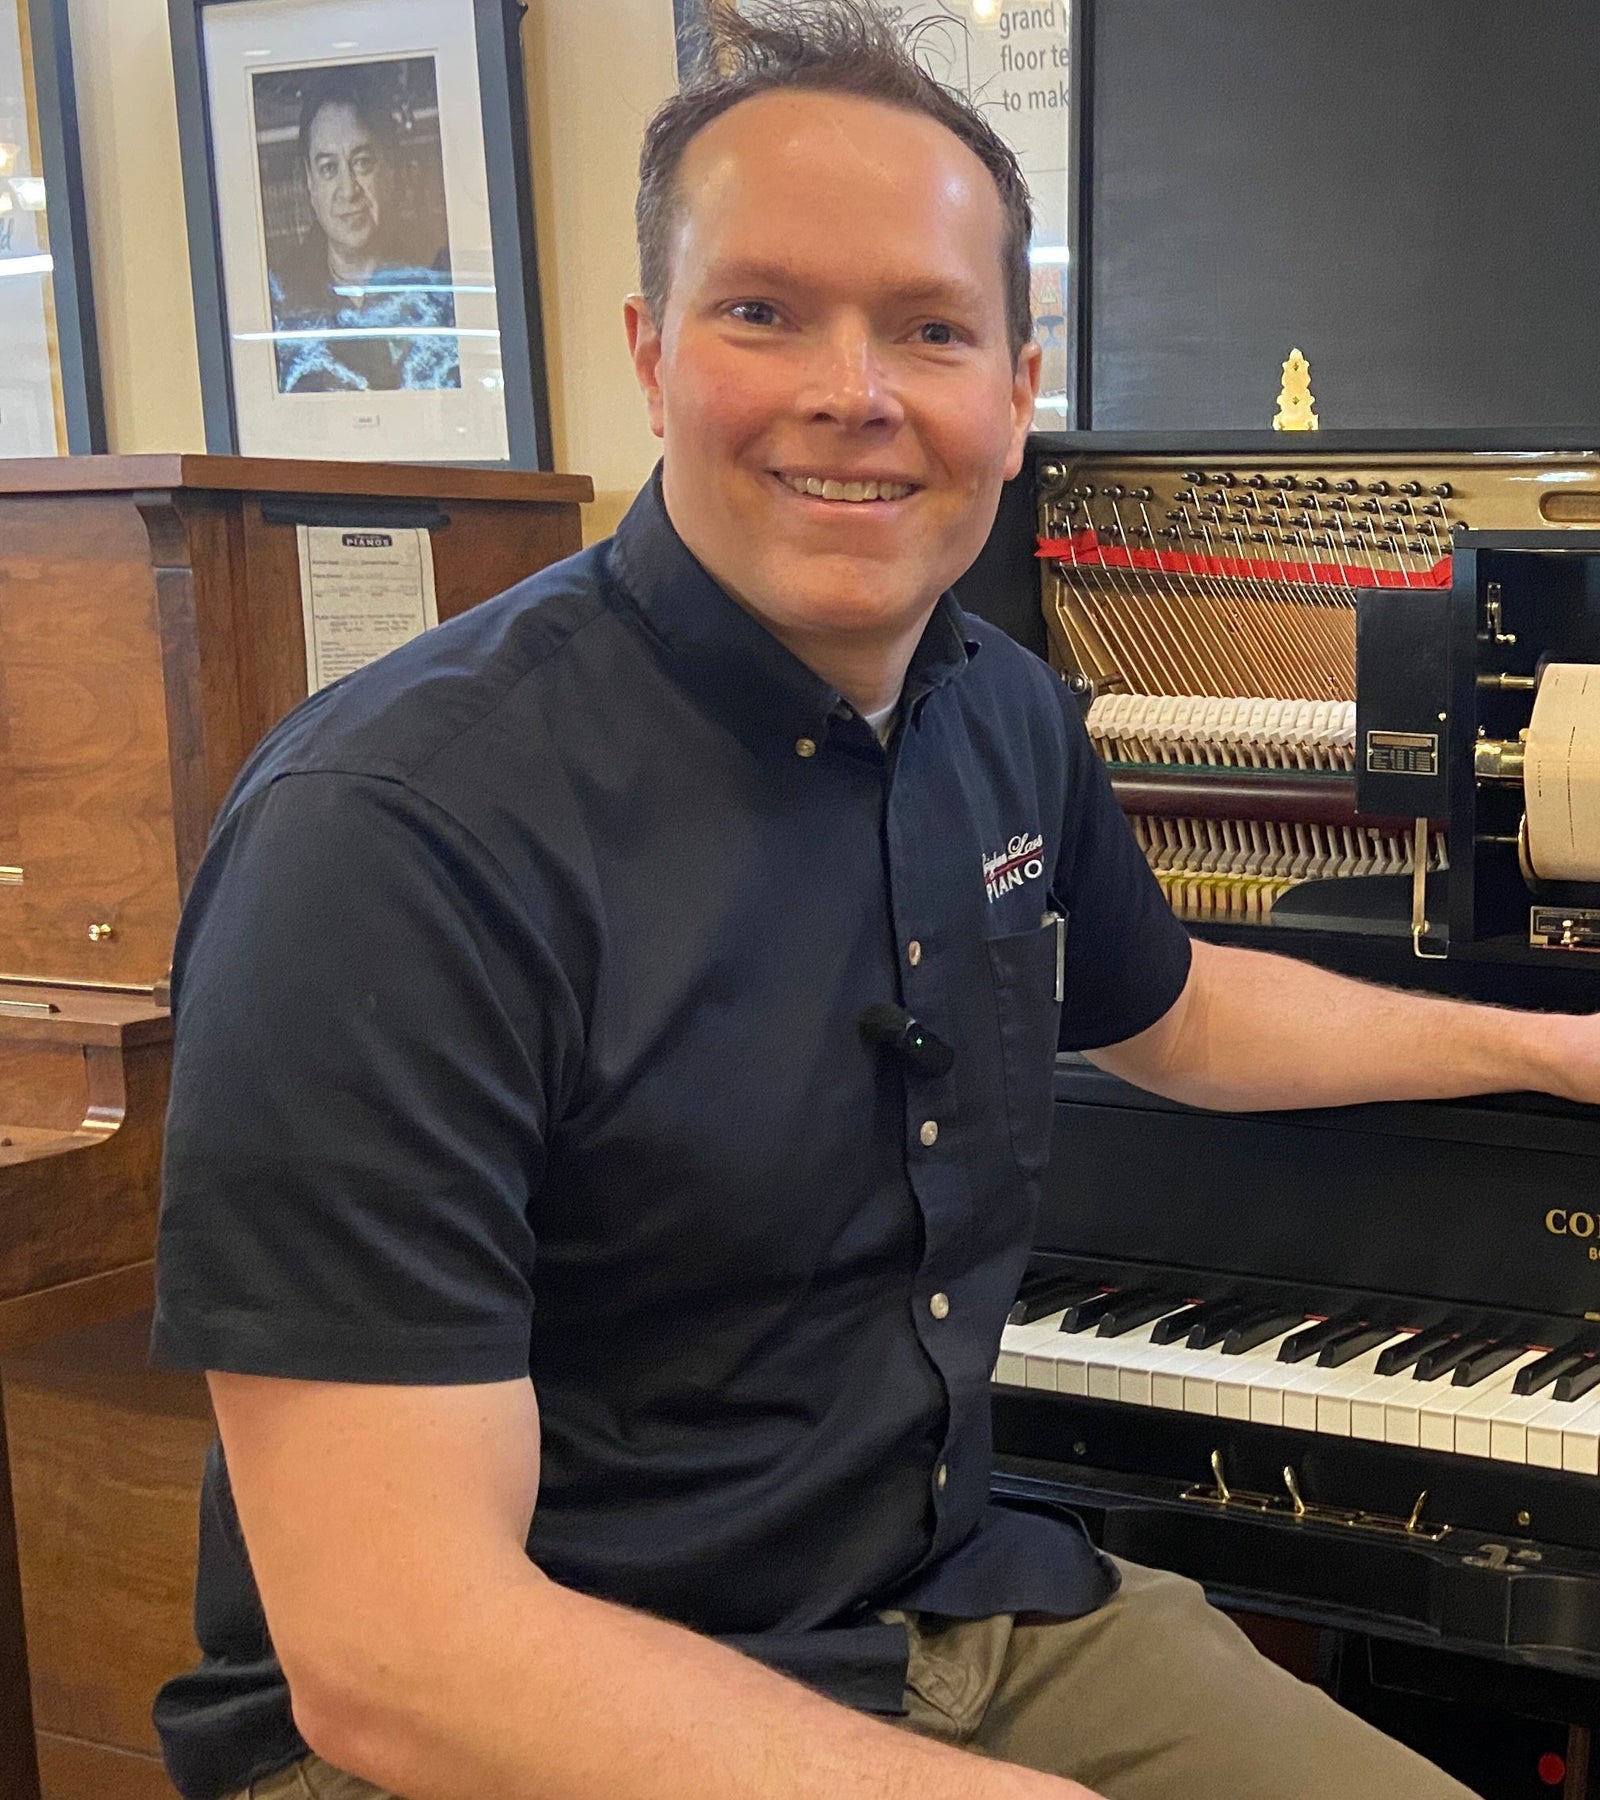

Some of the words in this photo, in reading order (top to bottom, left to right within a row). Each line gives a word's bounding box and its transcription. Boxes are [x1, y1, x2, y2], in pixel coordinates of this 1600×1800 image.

[999, 0, 1055, 39] grand
[999, 44, 1045, 72] floor
[1002, 88, 1021, 112] to
[1028, 80, 1069, 110] mak
[986, 857, 1044, 904] PIANO
